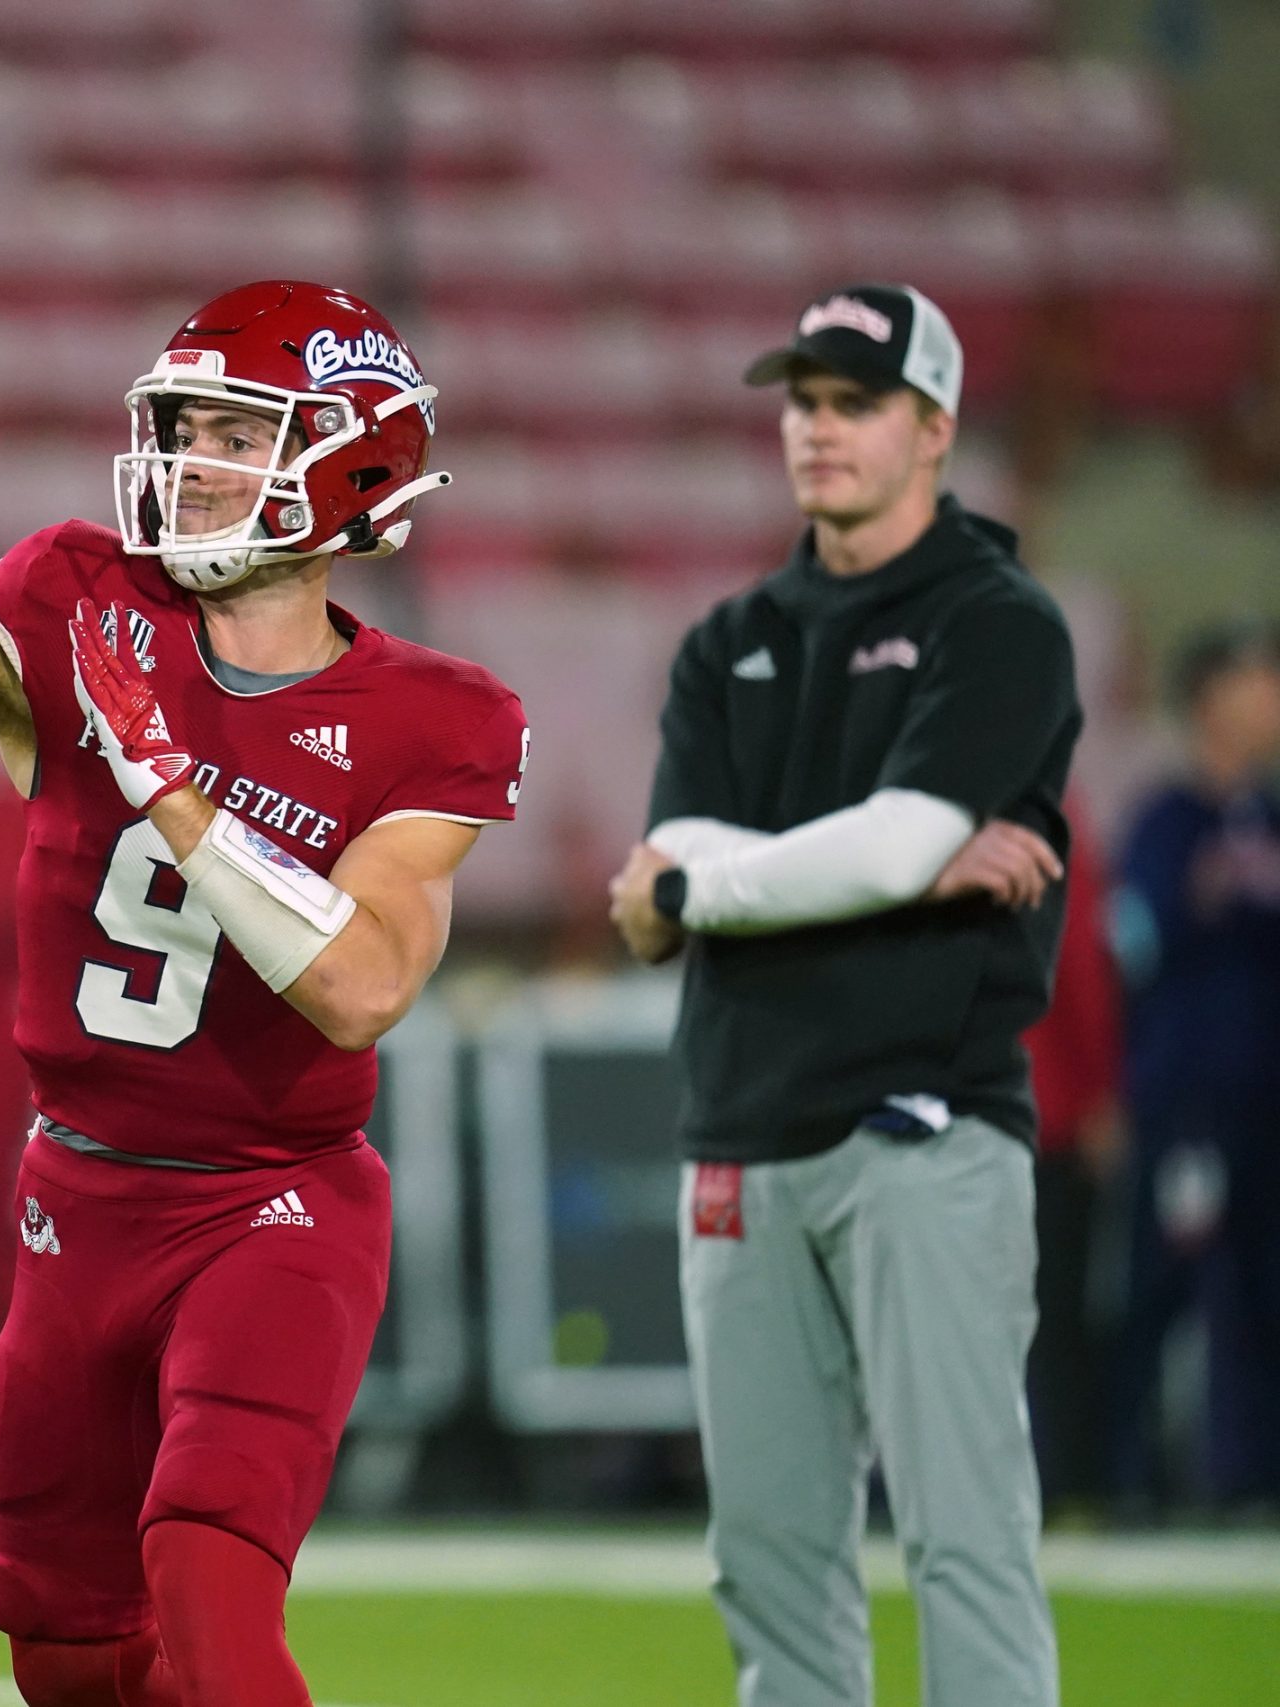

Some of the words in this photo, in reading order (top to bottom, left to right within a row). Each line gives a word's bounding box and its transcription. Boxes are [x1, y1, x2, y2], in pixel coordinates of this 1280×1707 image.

[289, 731, 353, 772] adidas
[223, 776, 338, 850] STATE
[75, 815, 222, 1050] 9
